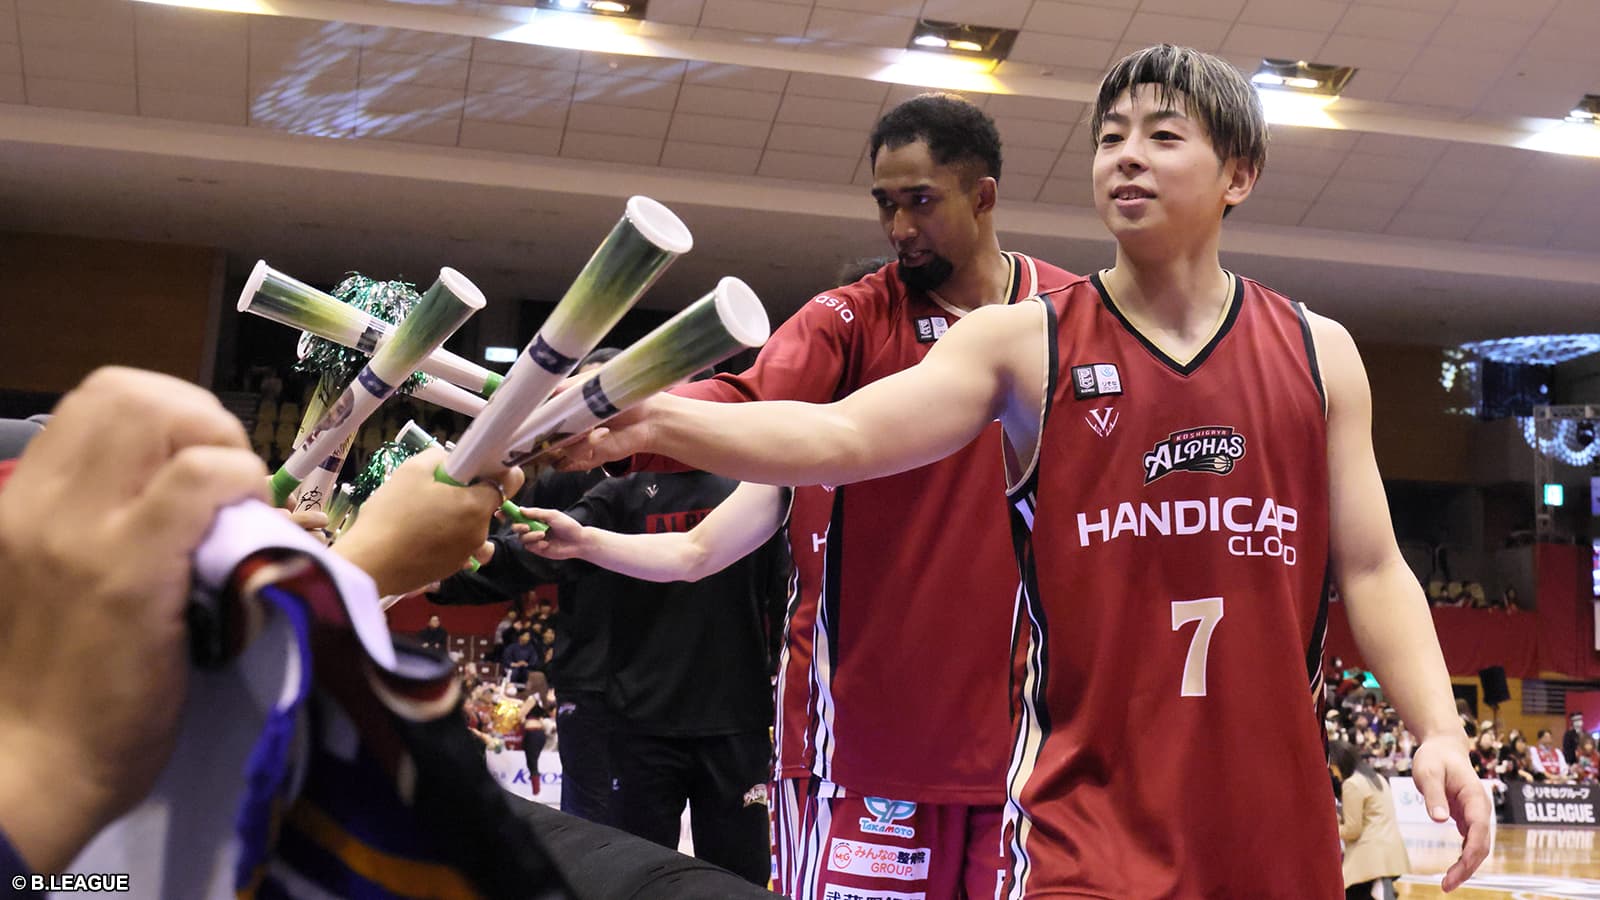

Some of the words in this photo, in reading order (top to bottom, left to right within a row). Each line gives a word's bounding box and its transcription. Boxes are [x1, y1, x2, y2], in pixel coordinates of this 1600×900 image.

[815, 294, 855, 324] asia
[1145, 436, 1243, 479] ALPHAS
[1076, 497, 1298, 547] HANDICAP
[1171, 597, 1224, 697] 7
[1524, 802, 1596, 823] B.LEAGUE
